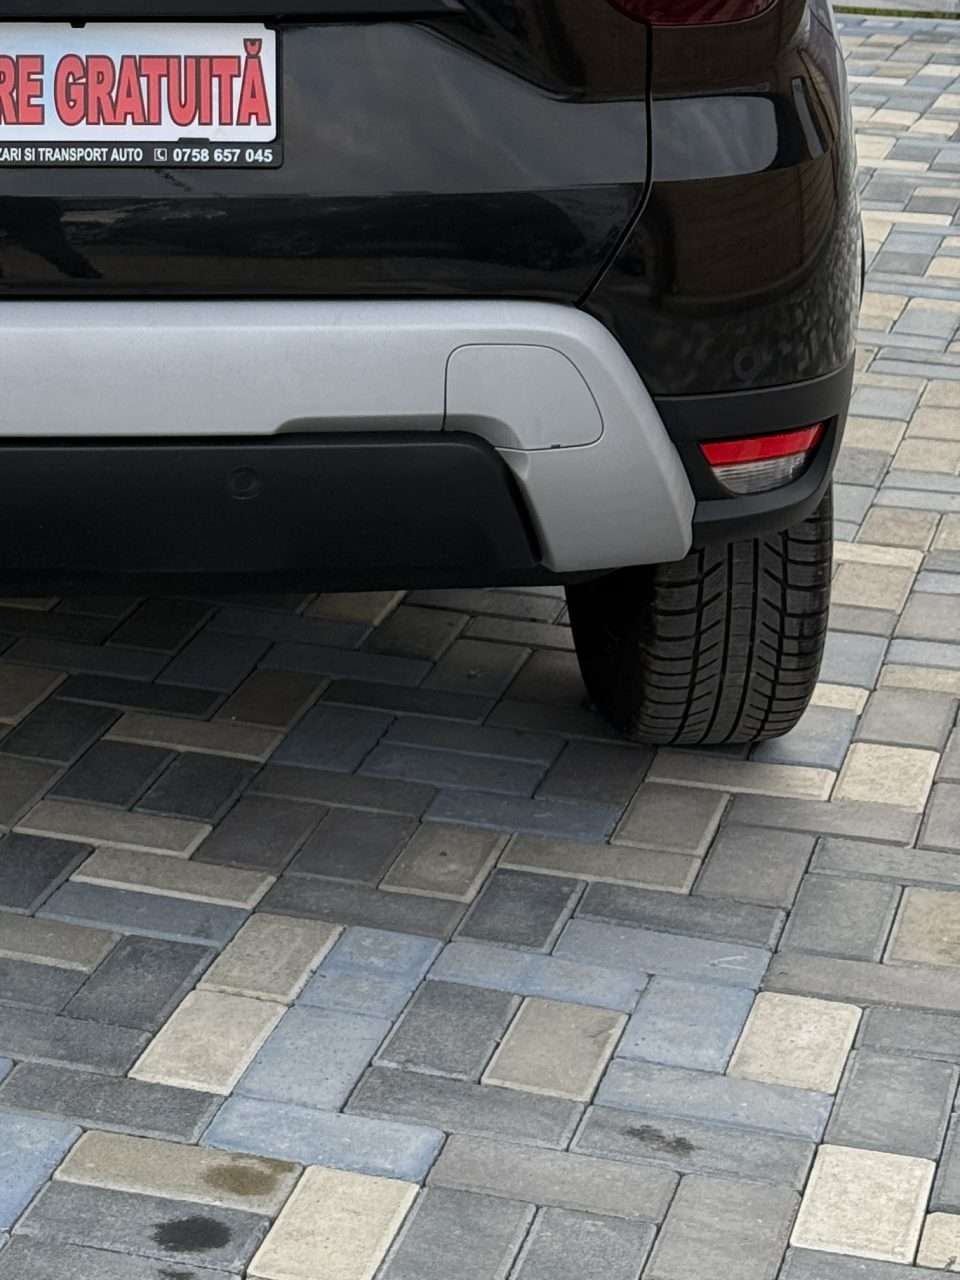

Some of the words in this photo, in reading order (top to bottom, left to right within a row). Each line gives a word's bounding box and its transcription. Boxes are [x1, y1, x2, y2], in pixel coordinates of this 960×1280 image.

[54, 38, 271, 126] GRATUITĂ
[24, 147, 36, 161] SI
[38, 148, 108, 162] TRANSPORT
[111, 148, 143, 162] AUTO
[173, 148, 210, 162] 0758
[213, 148, 241, 162] 657
[245, 149, 273, 163] 045
